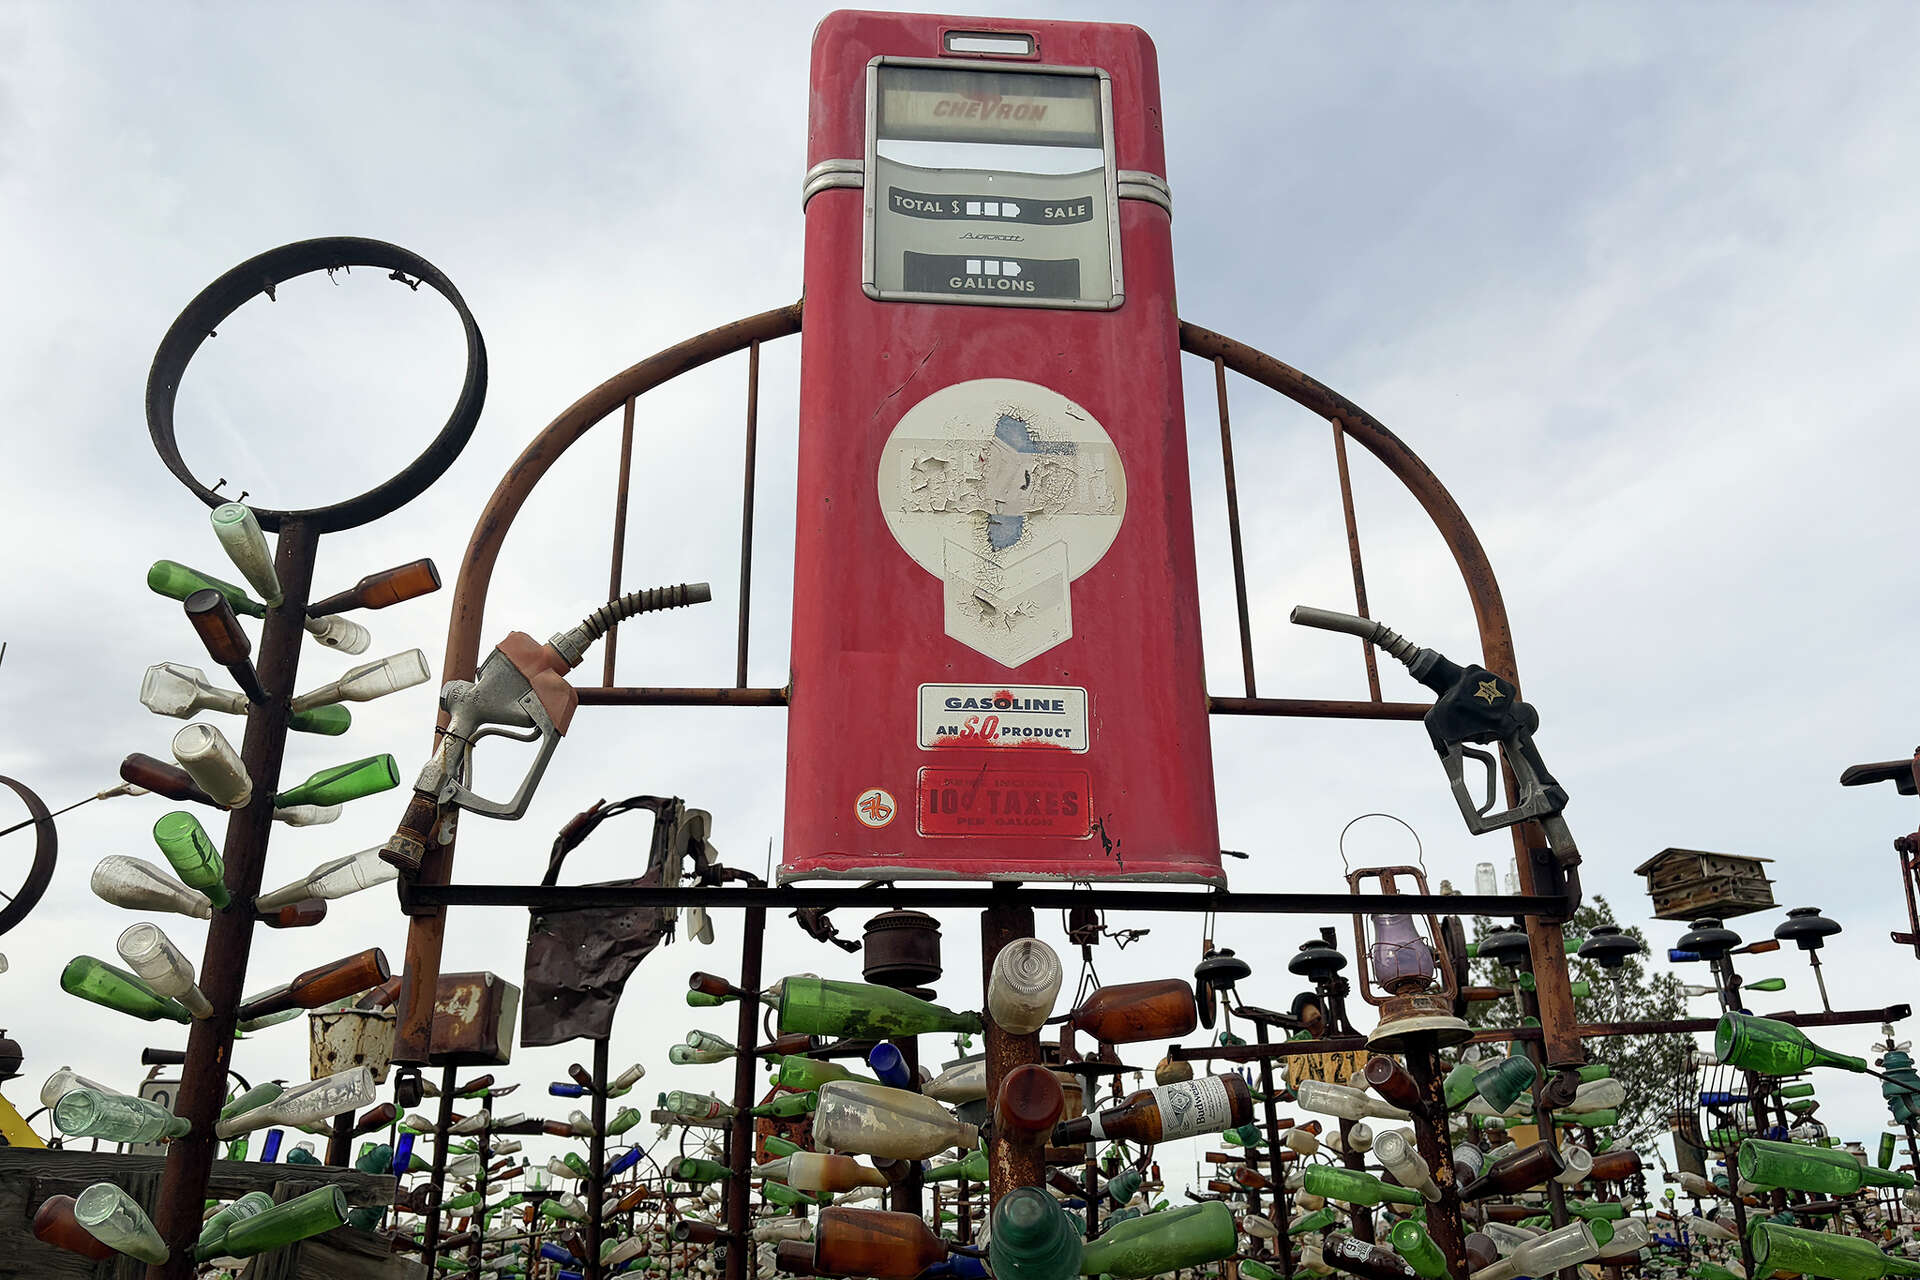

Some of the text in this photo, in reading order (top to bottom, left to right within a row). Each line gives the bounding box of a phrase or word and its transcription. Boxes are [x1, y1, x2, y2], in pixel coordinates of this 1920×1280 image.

[933, 99, 1049, 121] CHEVRON
[893, 195, 1087, 219] TOTAL $ SALE
[948, 276, 1036, 293] GALLONS
[944, 696, 1065, 712] GASOLINE
[936, 714, 1072, 740] AN S.O. PRODUCT
[986, 789, 1079, 817] TAXES
[956, 816, 1054, 827] PER GALLON
